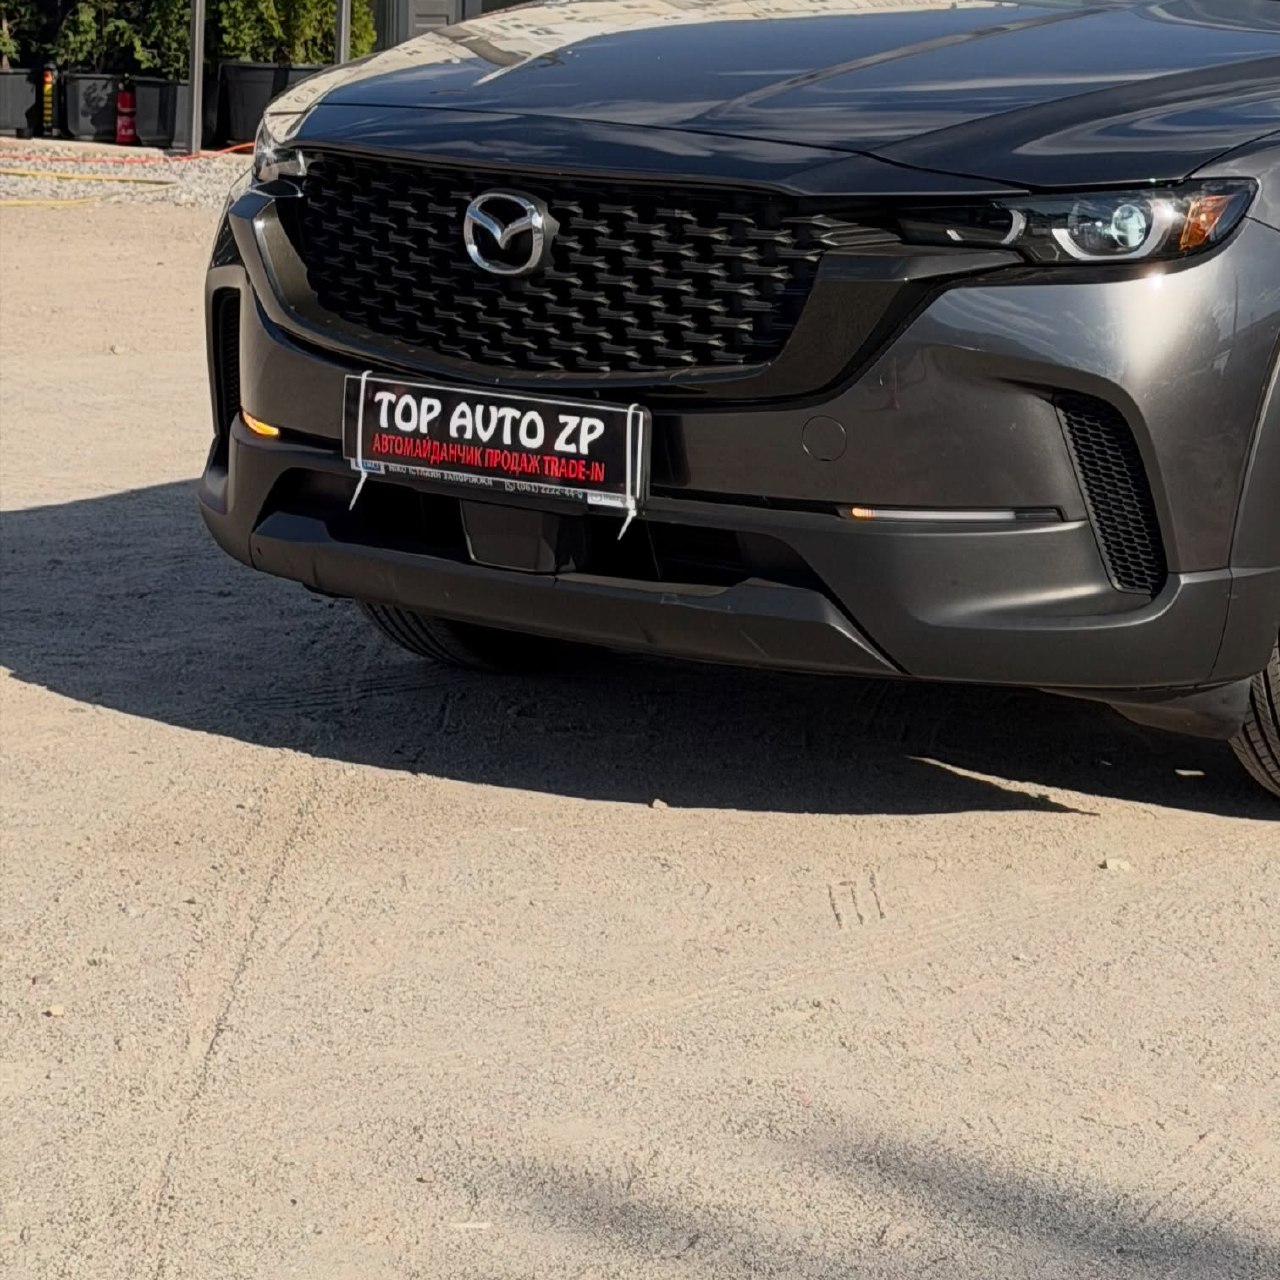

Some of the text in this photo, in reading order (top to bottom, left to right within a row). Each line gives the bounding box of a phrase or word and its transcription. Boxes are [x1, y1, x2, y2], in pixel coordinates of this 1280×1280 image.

[373, 391, 605, 455] TOP AVTO ZP
[372, 433, 483, 468] АВТОМАЙДАНЧИК
[484, 447, 540, 477] ПРОДАЖ
[543, 455, 605, 483] TRADE-IN
